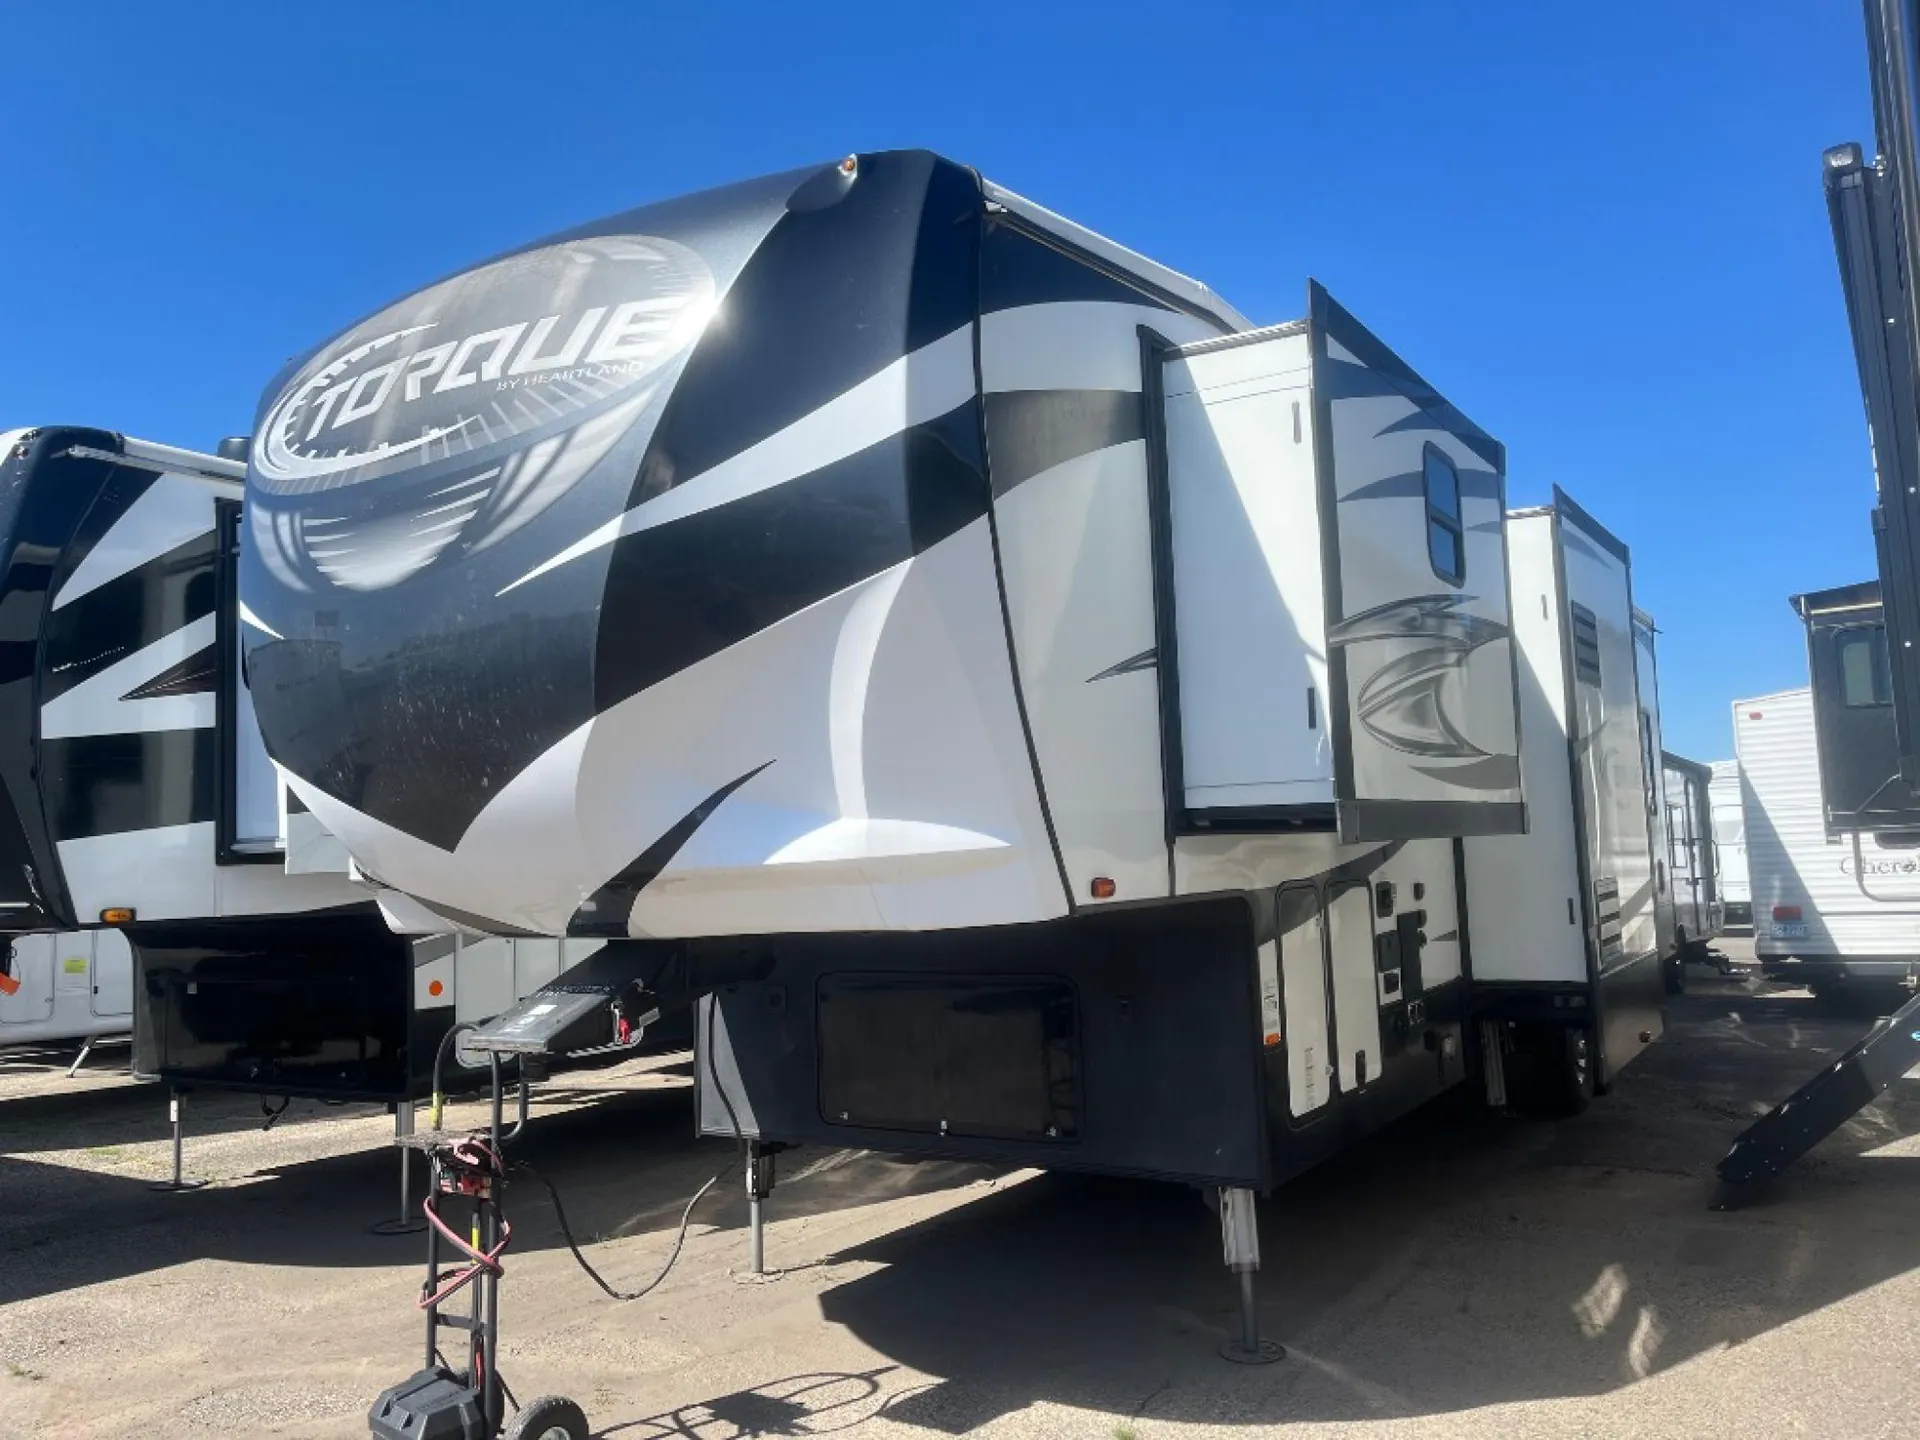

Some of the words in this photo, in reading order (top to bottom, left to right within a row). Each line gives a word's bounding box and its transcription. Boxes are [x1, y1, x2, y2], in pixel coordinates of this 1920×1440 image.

[305, 297, 688, 442] TORQUE
[496, 378, 520, 392] BY
[523, 360, 644, 387] HEARTLAND
[1840, 854, 1920, 875] Chero
